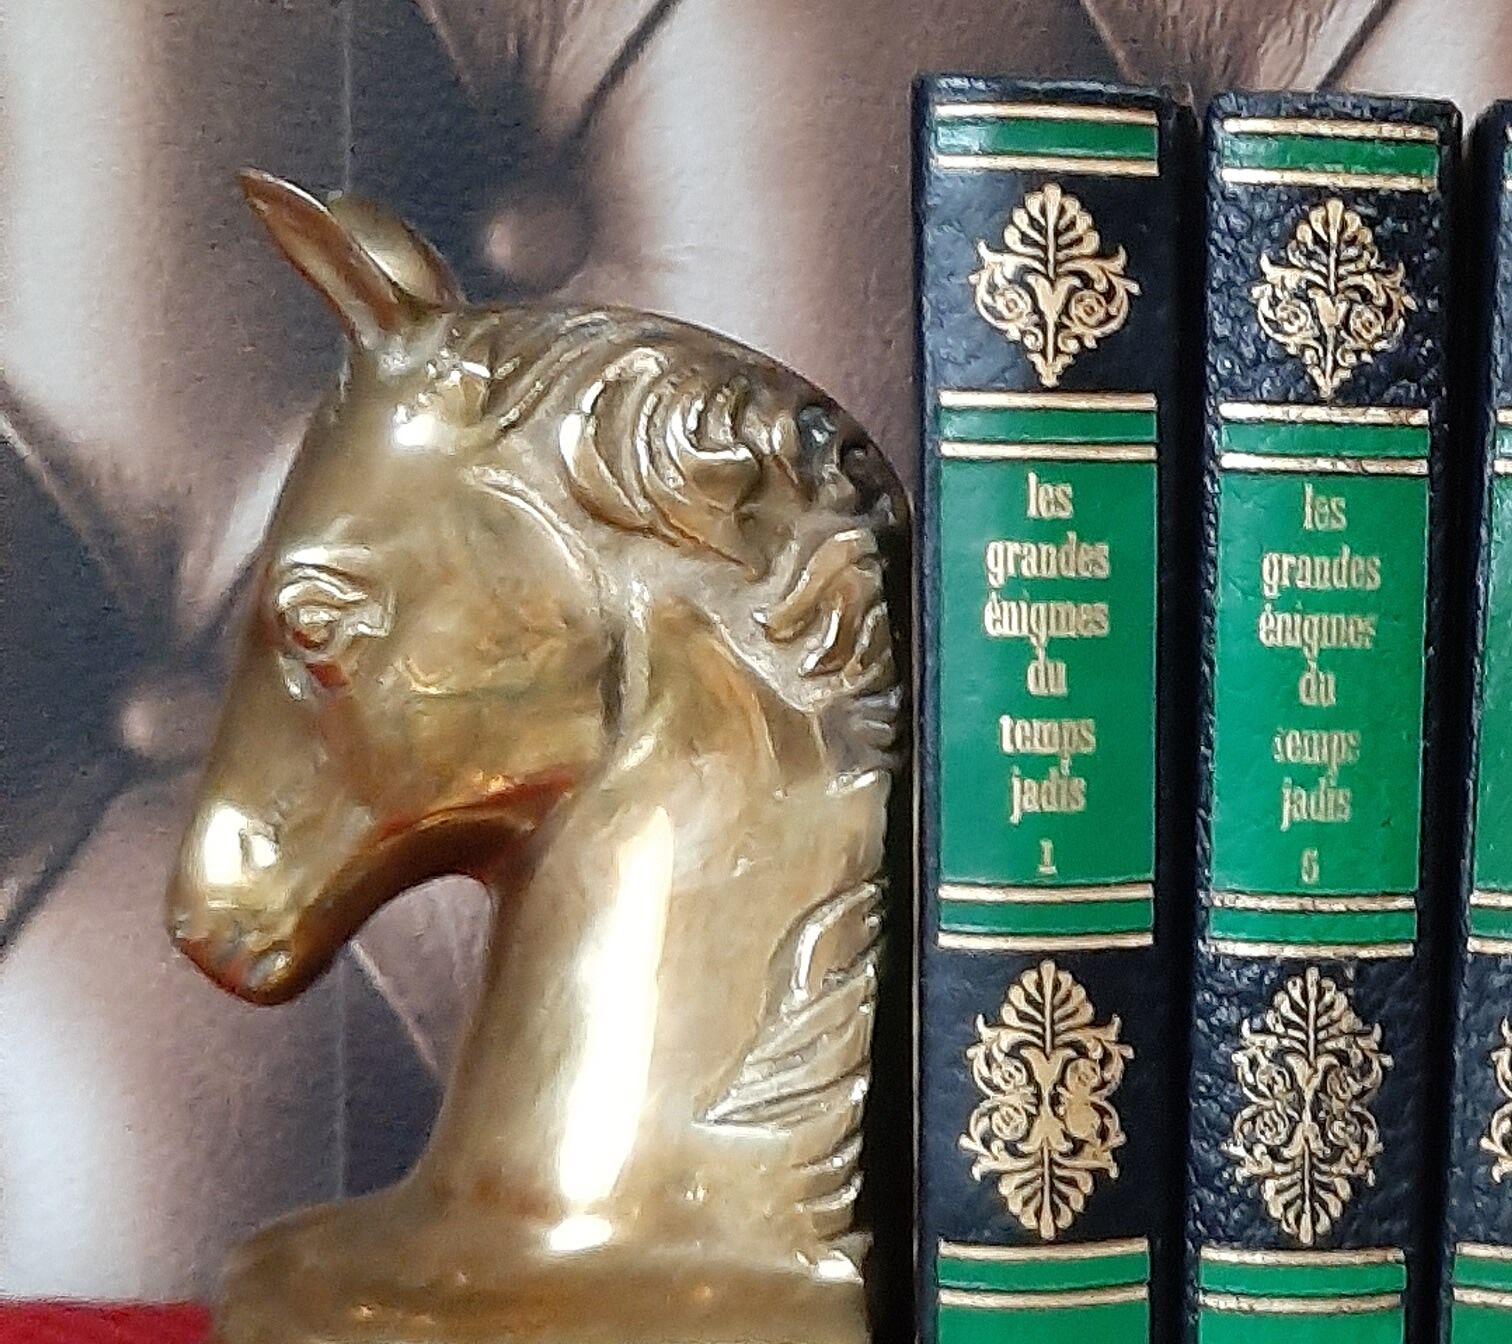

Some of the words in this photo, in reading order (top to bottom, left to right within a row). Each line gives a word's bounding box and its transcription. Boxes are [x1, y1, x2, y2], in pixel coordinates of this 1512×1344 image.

[1027, 471, 1073, 519] les
[1304, 483, 1346, 531] les
[986, 531, 1109, 587] grandes
[1262, 544, 1381, 598] grandes
[984, 592, 1109, 651] énigmes
[1027, 647, 1067, 696] du
[1299, 658, 1335, 707] du
[1000, 714, 1096, 771] temps
[1009, 765, 1087, 825] jadis
[1280, 775, 1352, 831] jadis
[1038, 839, 1058, 874] 1
